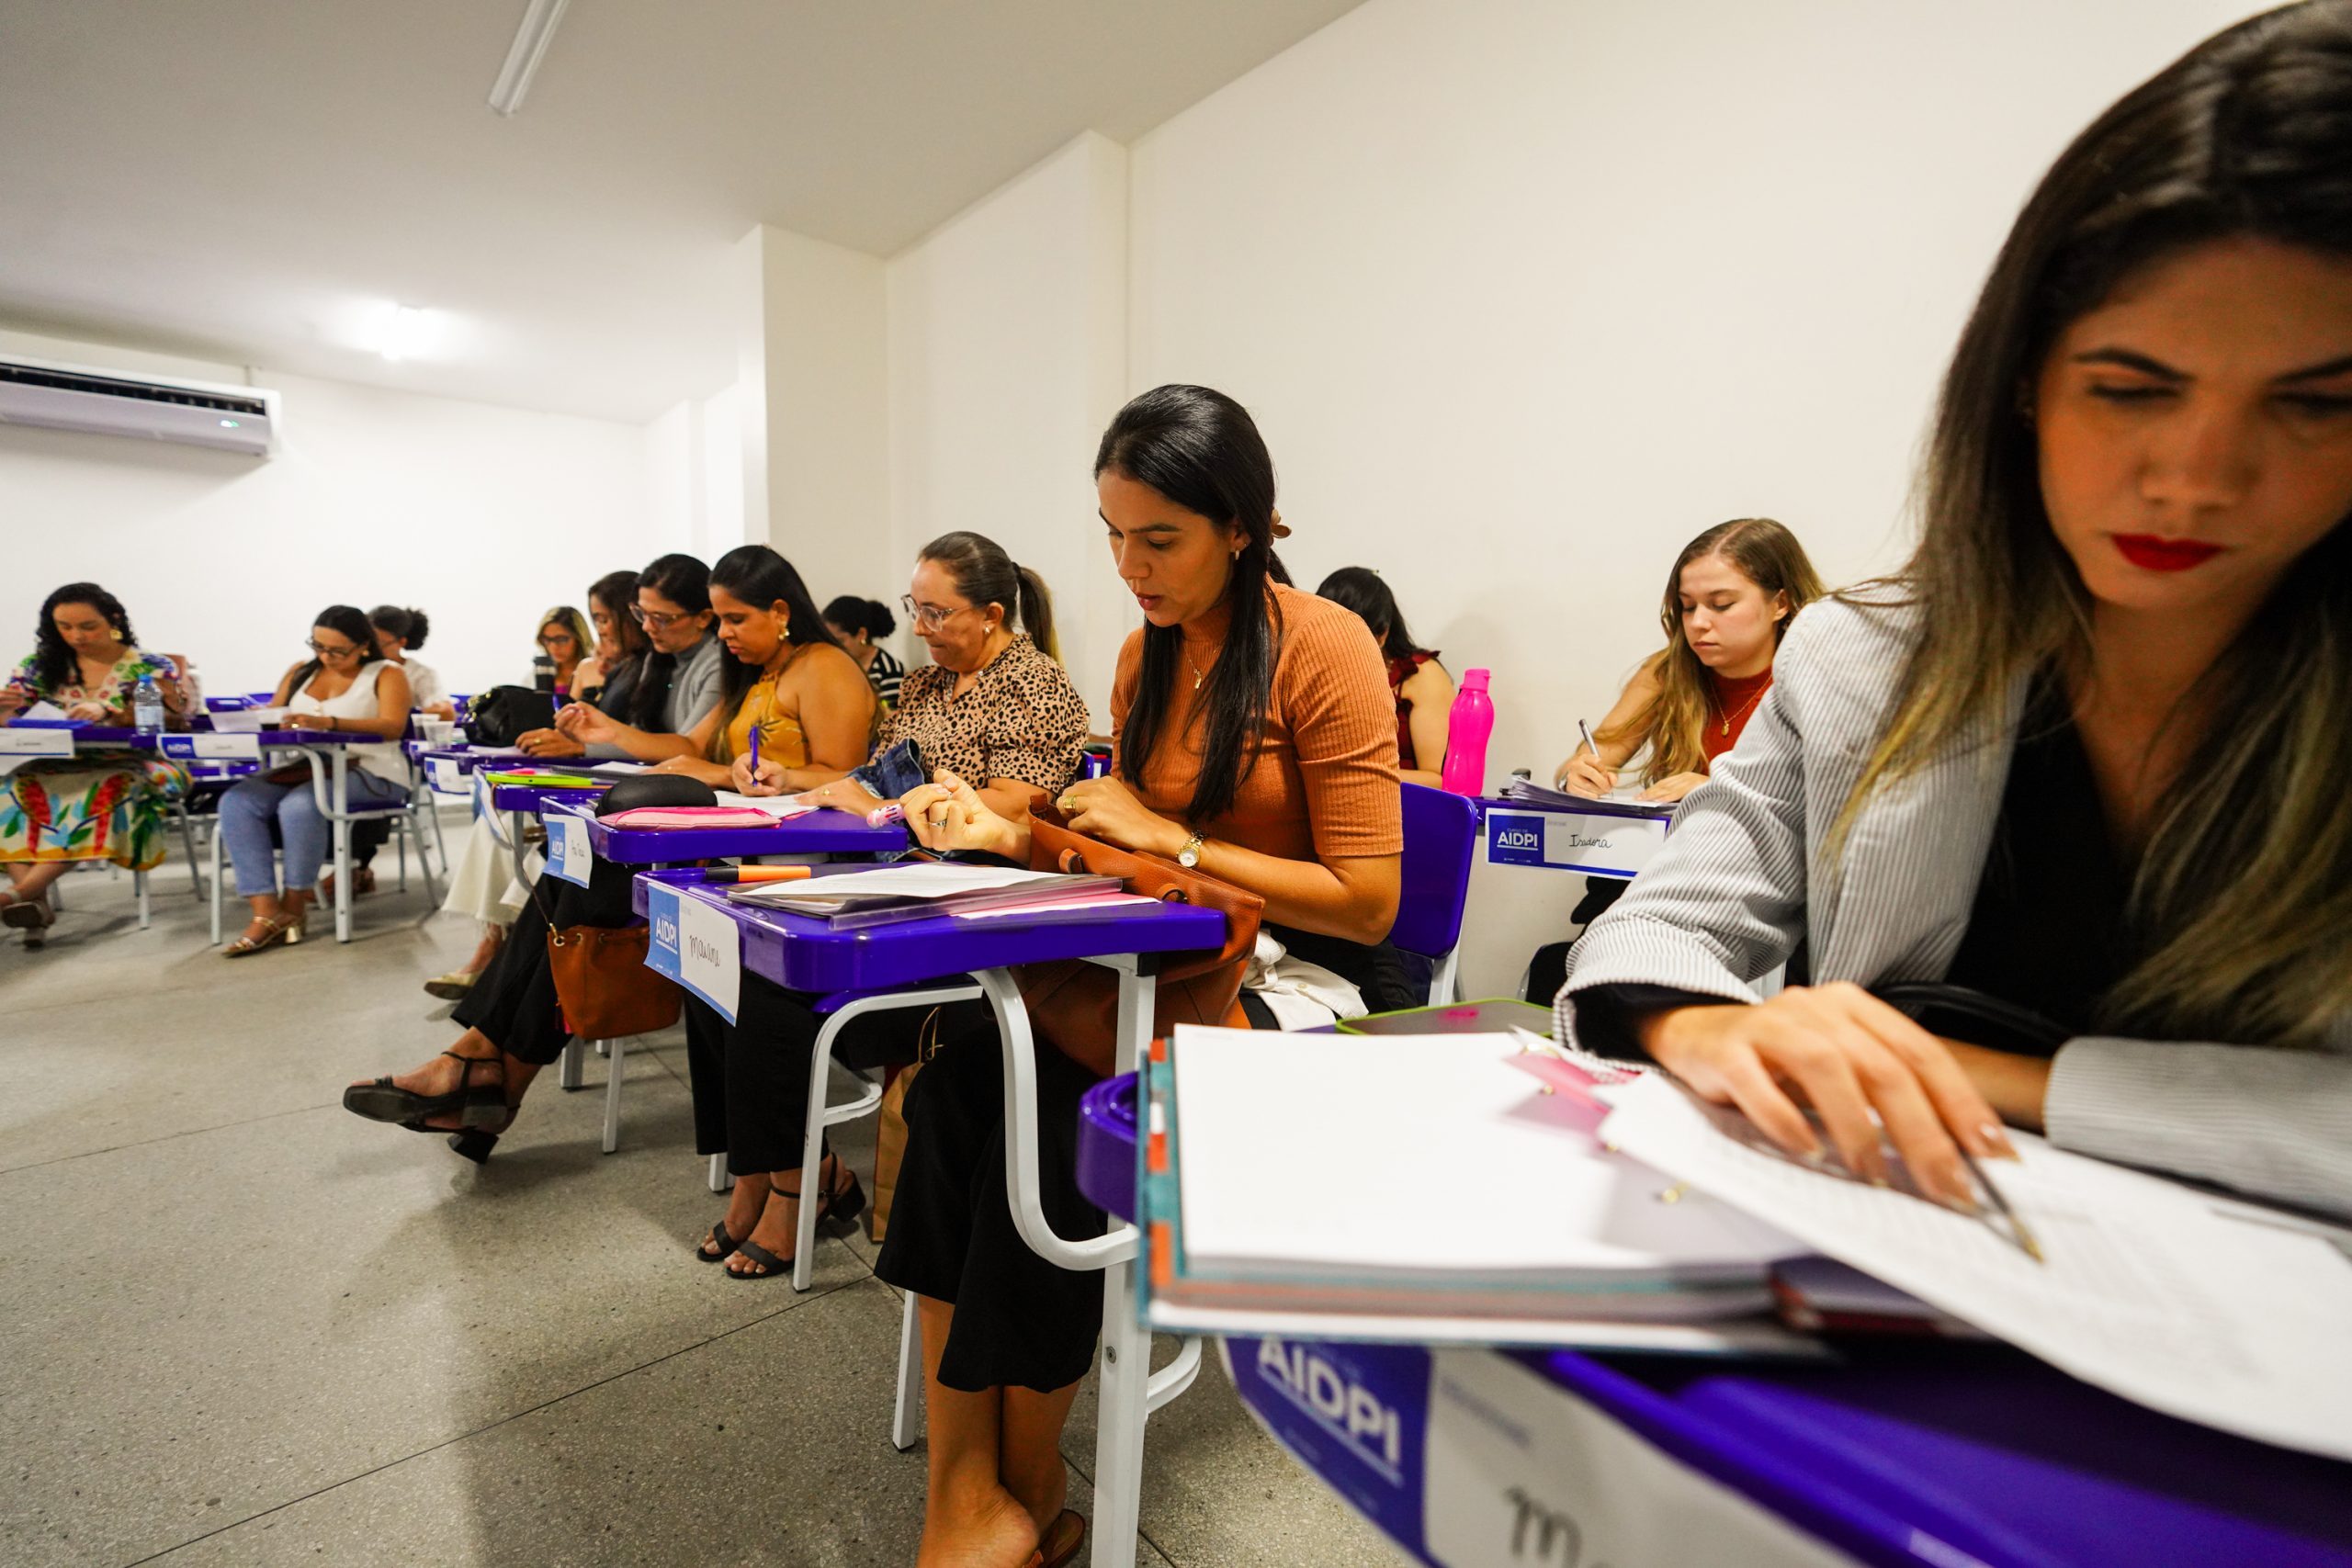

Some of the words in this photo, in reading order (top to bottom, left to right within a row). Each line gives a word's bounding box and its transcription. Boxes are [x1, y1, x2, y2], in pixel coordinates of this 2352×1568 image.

[1498, 831, 1538, 847] AIDPI
[656, 917, 677, 948] AIDPI
[1257, 1334, 1401, 1468] AIDPI
